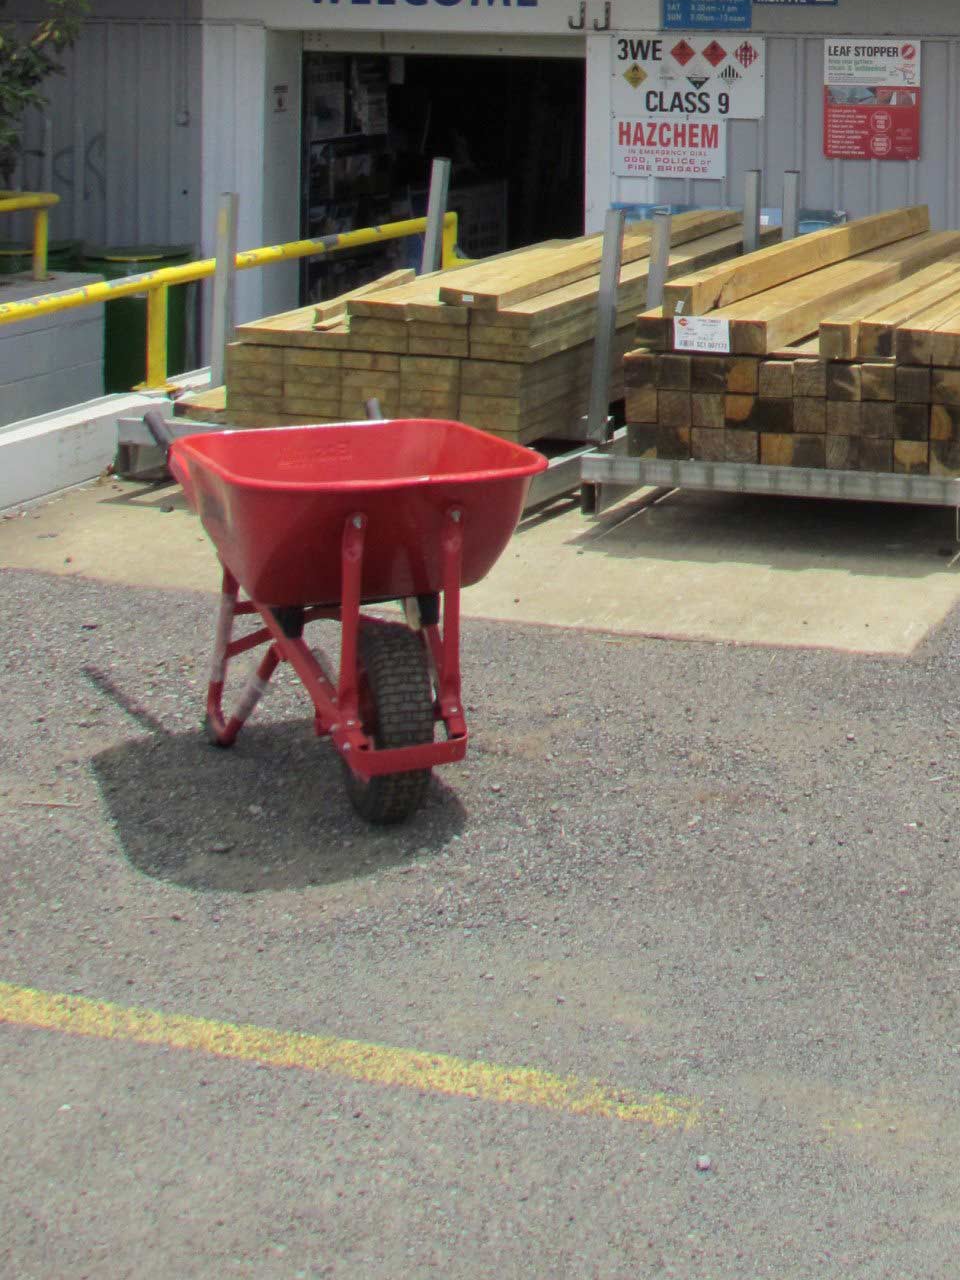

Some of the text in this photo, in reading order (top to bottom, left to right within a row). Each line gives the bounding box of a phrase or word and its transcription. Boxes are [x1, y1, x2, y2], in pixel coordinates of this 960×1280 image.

[617, 38, 662, 61] 3WE
[828, 45, 899, 58] LEAF STOPPER
[645, 90, 730, 114] CLASS 9
[618, 120, 719, 149] HAZCHEM
[639, 149, 687, 157] EMERGENCY
[654, 157, 696, 165] POLICE
[627, 163, 709, 174] FIRE BRIGADE
